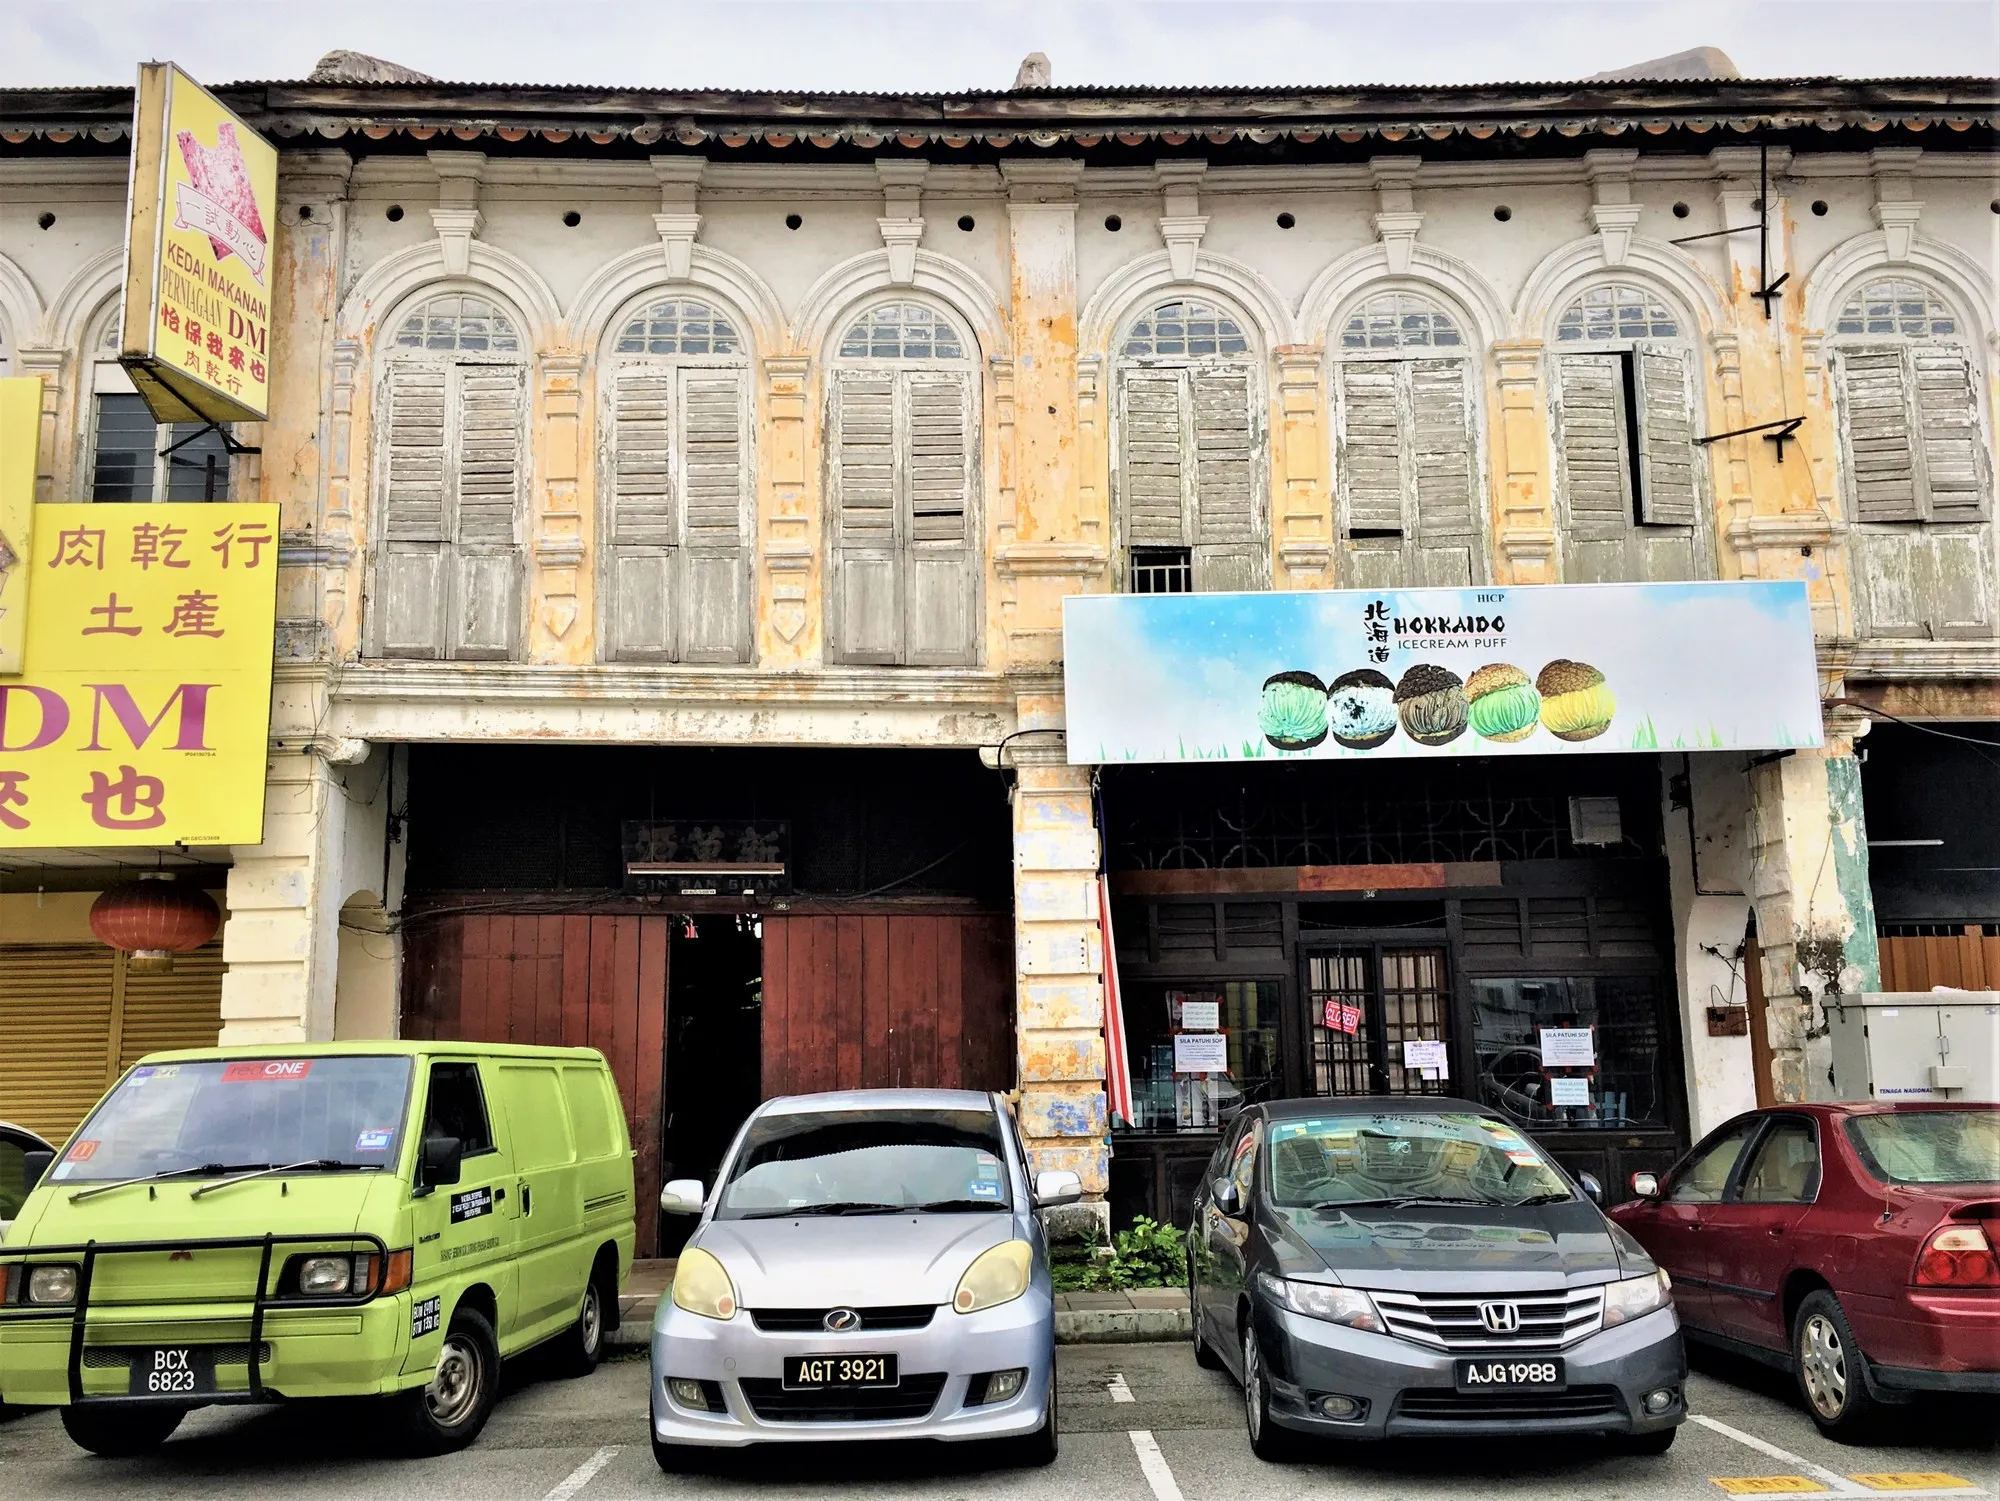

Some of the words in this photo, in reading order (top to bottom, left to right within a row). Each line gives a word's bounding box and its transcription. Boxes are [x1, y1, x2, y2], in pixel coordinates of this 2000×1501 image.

[168, 240, 205, 282] KEDAI
[208, 268, 267, 322] MAKANAN
[162, 265, 223, 328] PERNIAGAAN
[228, 307, 267, 355] DM
[184, 350, 243, 396] 肉乾行
[48, 522, 272, 570] 肉乾行
[82, 589, 225, 638] 土產
[1477, 594, 1505, 603] HICP
[1364, 600, 1391, 664] 北海道
[1394, 615, 1506, 635] HOKKAIDO
[1398, 638, 1469, 650] ICECREAM
[1475, 637, 1507, 648] PUFF
[0, 684, 222, 752] DM
[1326, 1008, 1357, 1027] CLOSED
[155, 1350, 188, 1370] BCX
[799, 1361, 835, 1383] AGT
[838, 1359, 885, 1381] 3921
[149, 1371, 194, 1391] 6823
